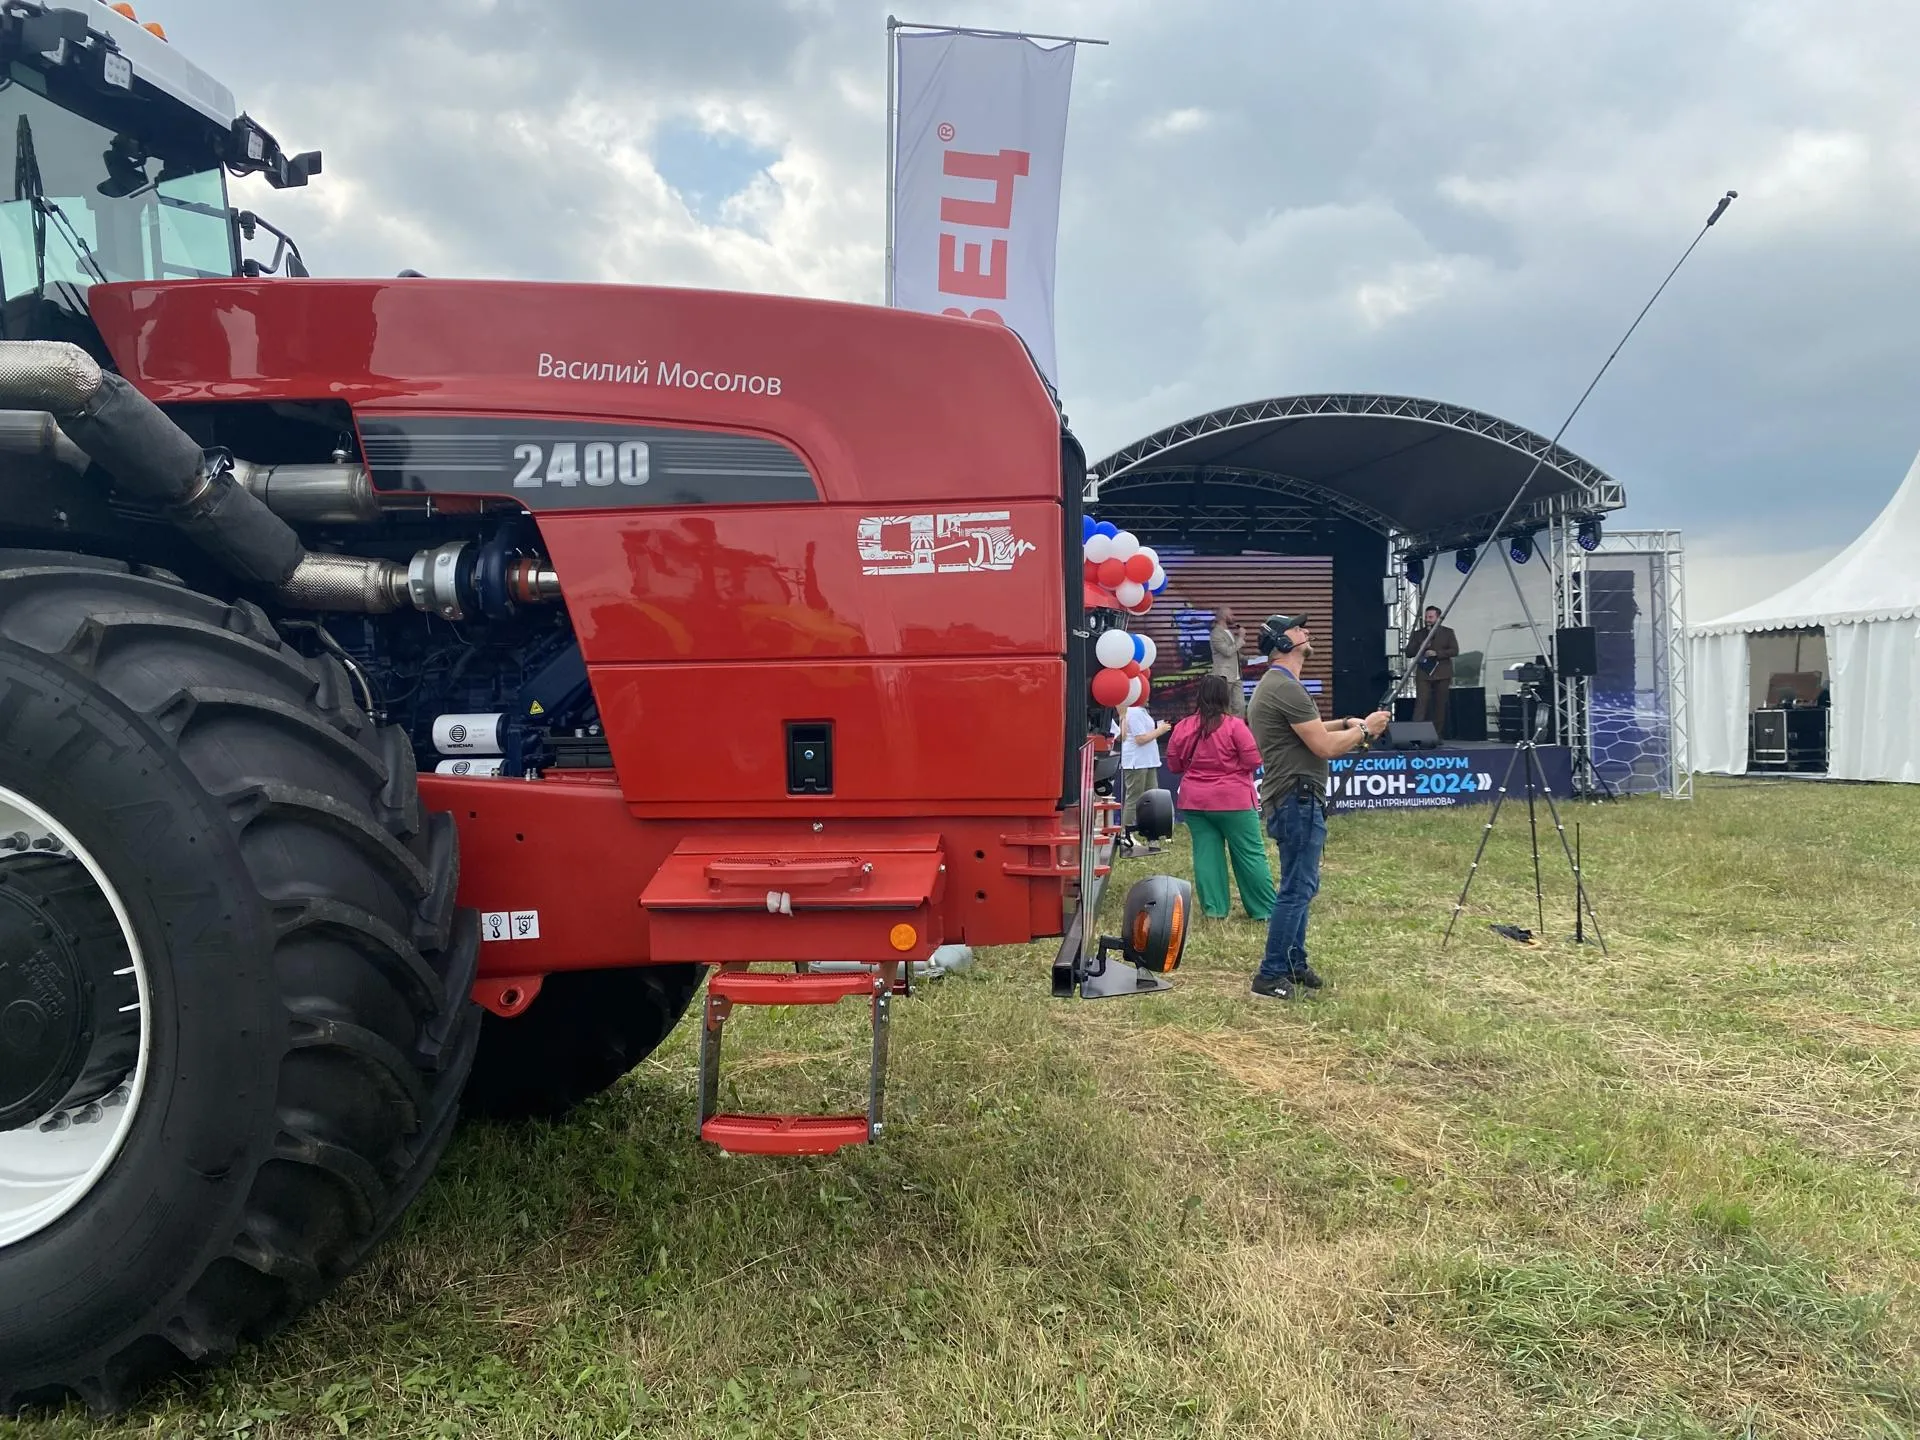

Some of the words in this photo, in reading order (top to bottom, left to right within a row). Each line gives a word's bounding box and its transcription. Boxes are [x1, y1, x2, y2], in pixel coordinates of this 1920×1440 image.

[537, 353, 649, 385] Василий
[656, 361, 782, 396] Мосолов
[513, 440, 650, 488] 2400
[1411, 756, 1469, 770] ФОРУМ
[1336, 800, 1366, 809] ИМЕНИ
